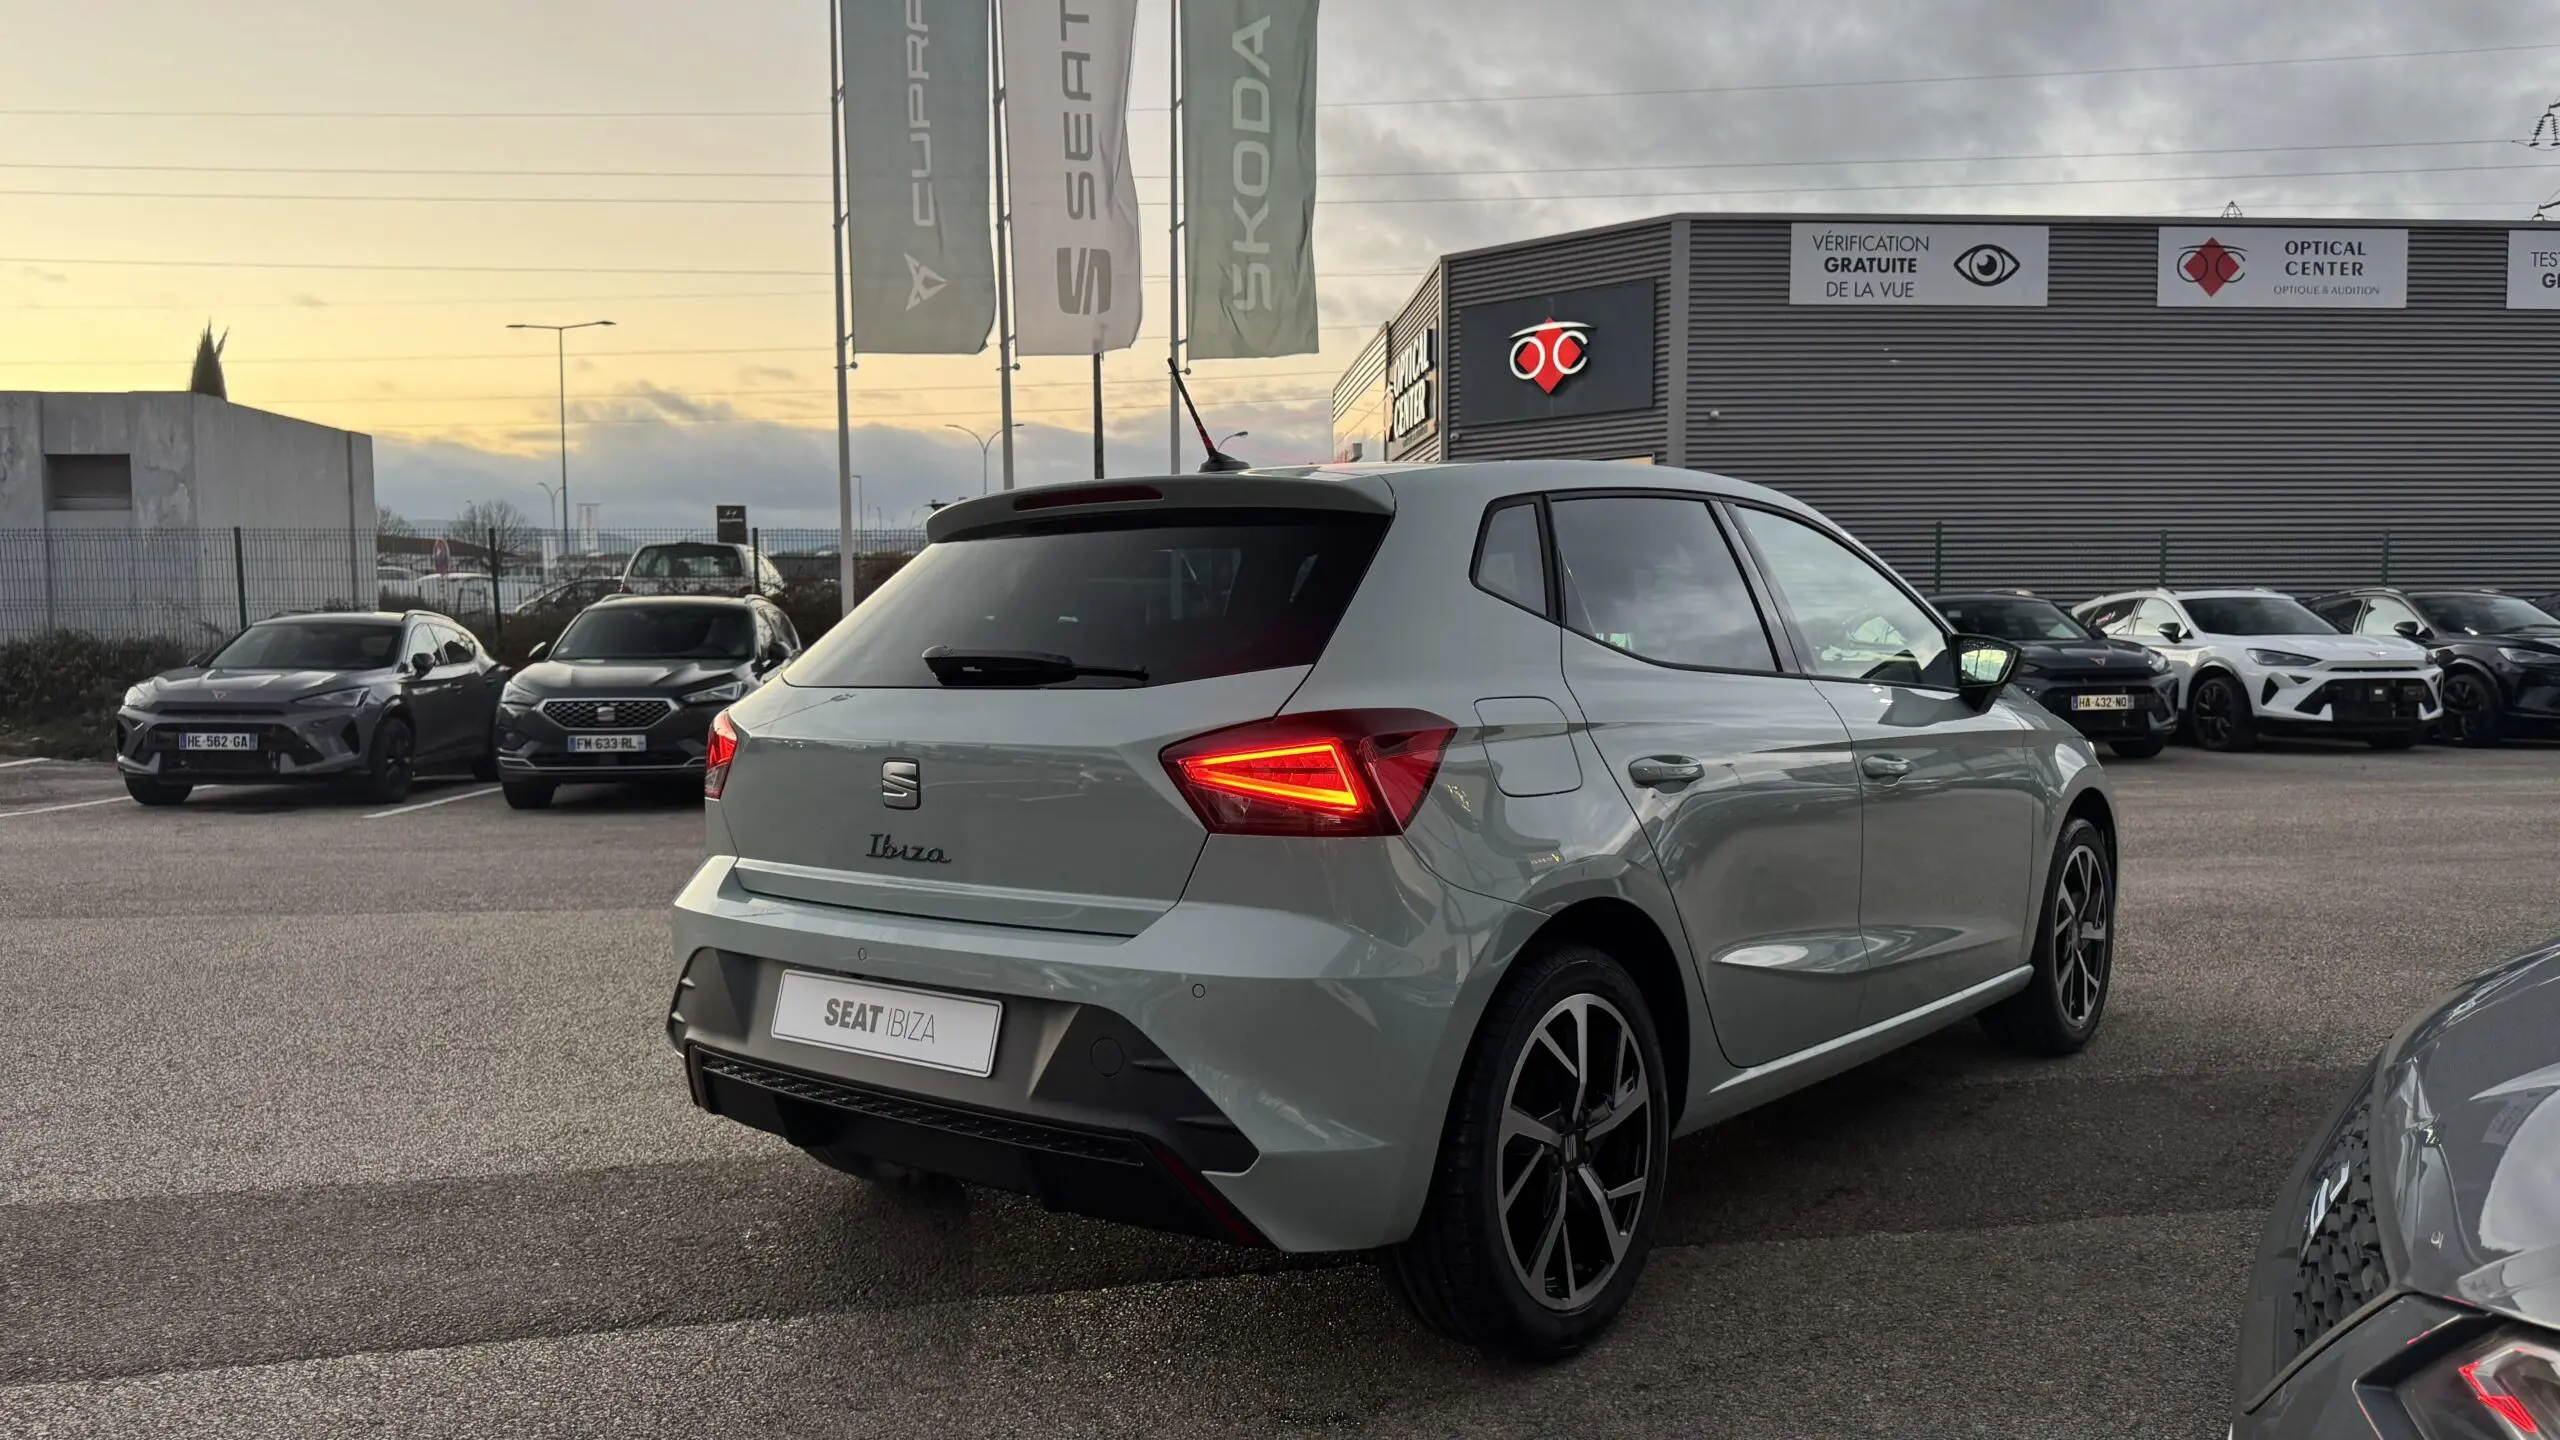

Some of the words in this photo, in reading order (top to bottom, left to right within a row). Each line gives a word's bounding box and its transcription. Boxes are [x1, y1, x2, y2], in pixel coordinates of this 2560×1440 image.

[1059, 0, 1096, 220] SEAT
[1812, 230, 1929, 252] VÉRIFICATION
[2284, 240, 2367, 256] OPTICAL
[1824, 257, 1917, 273] GRATUITE
[2284, 261, 2364, 276] CENTER
[1826, 281, 1848, 298] DE
[1854, 281, 1874, 298] LA
[1880, 281, 1914, 298] VUE
[2273, 285, 2319, 295] OPTIQUE
[2331, 286, 2380, 295] AUDITION
[1393, 378, 1426, 440] CENTER
[865, 833, 952, 863] Ibiza
[824, 998, 884, 1033] SEAT
[885, 1008, 935, 1044] IBIZA
